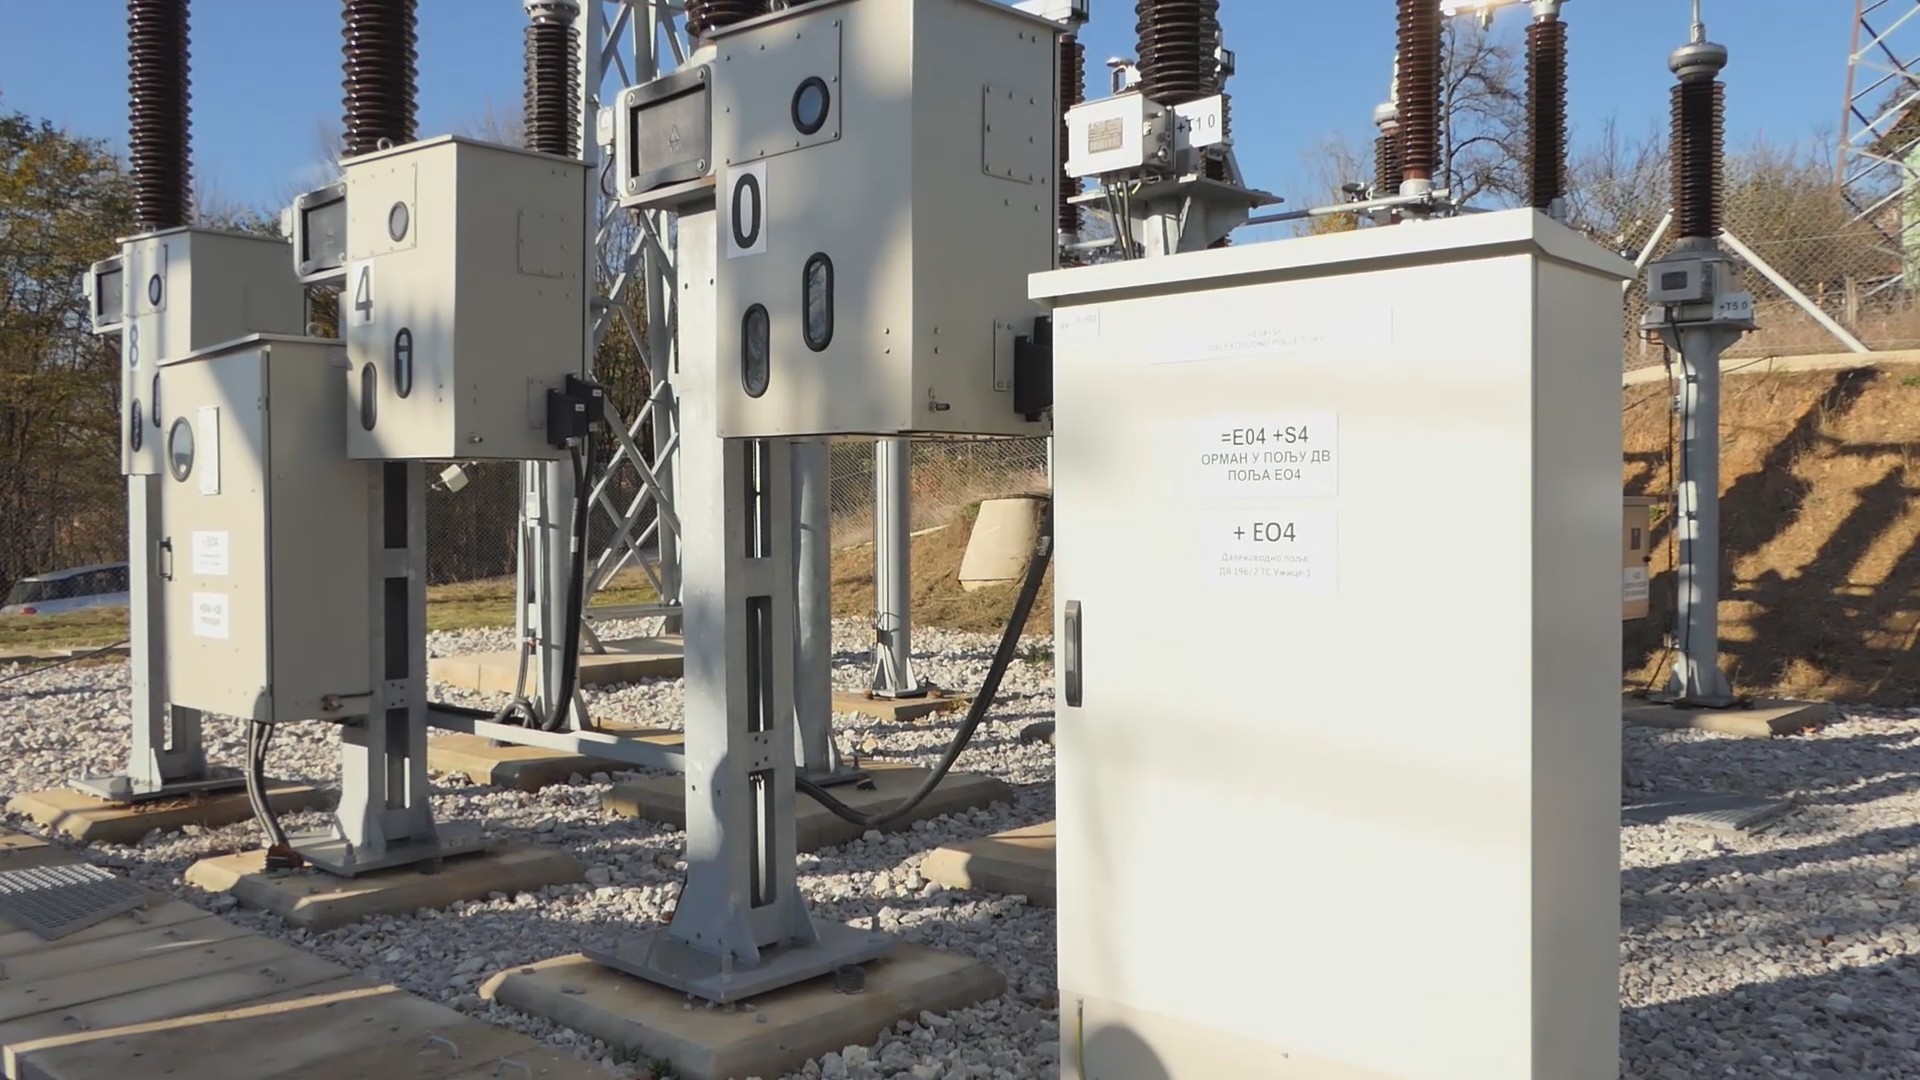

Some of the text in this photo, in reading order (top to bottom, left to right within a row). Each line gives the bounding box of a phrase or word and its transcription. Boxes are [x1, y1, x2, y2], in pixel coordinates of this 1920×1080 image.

[732, 173, 761, 249] 0
[355, 265, 373, 321] 4
[129, 324, 139, 367] 8
[1221, 425, 1309, 446] =E04 +S4
[1201, 450, 1331, 465] ОРМАН У ПОЉУ ДВ
[1228, 469, 1271, 481] ПОЉА
